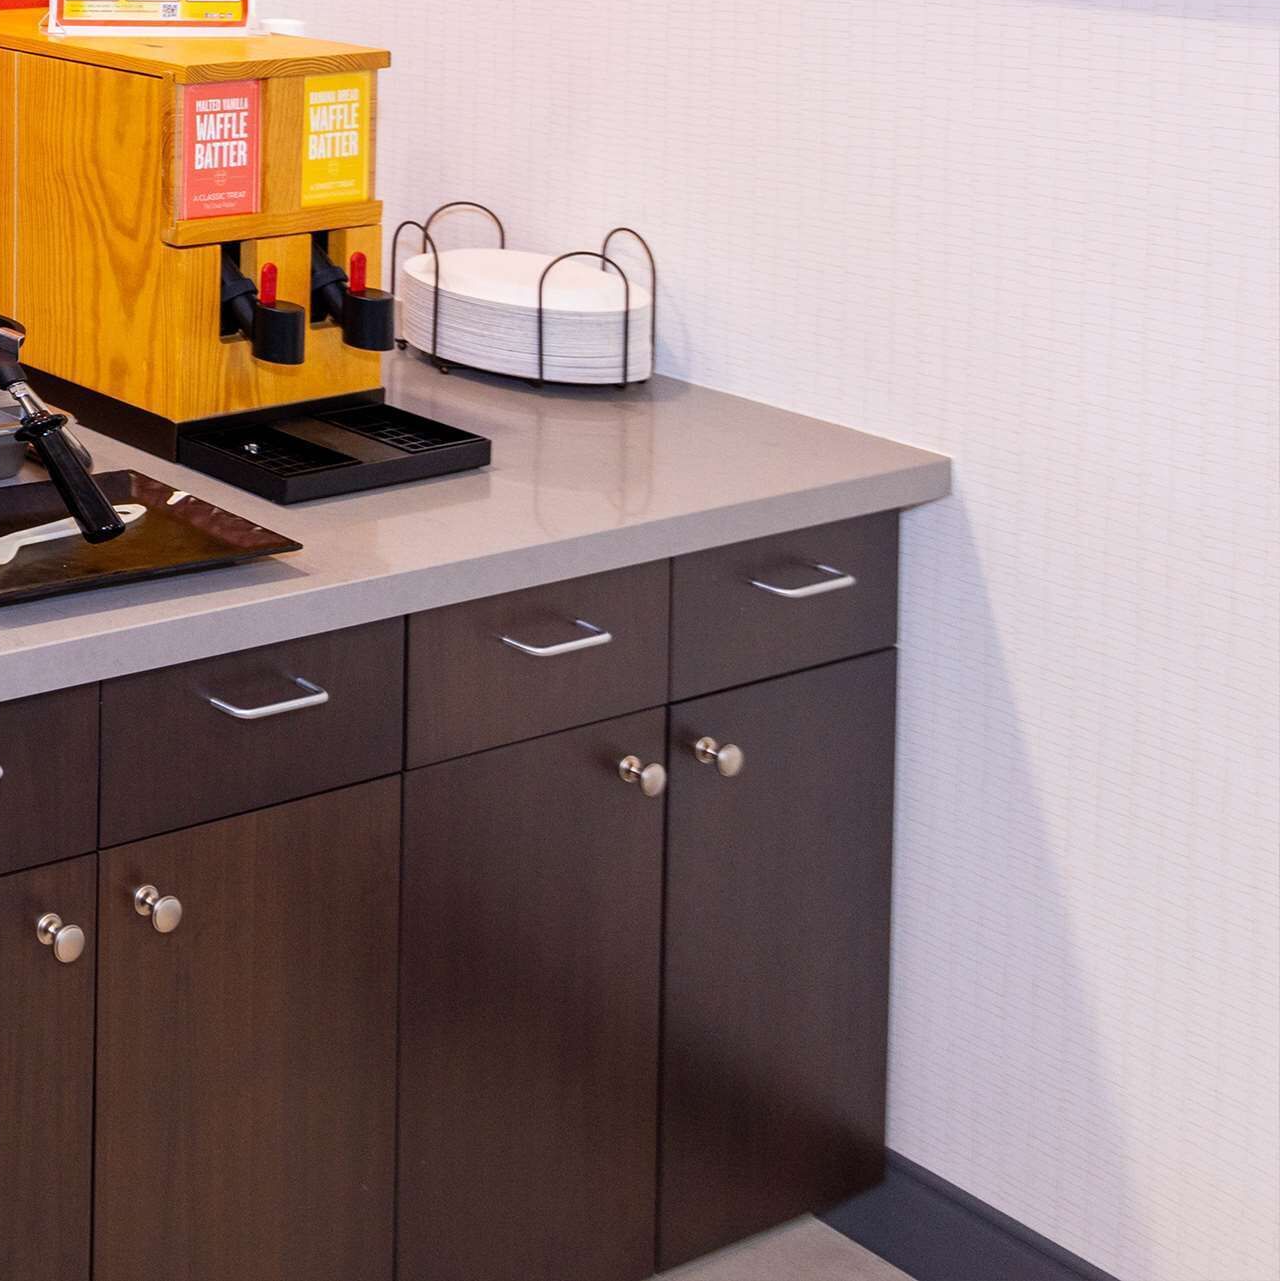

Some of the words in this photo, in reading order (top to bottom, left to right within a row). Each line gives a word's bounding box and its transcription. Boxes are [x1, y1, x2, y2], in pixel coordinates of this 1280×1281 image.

[196, 111, 249, 141] WAFFLE
[309, 102, 360, 133] WAFFLE
[194, 140, 247, 170] BATTER
[308, 130, 359, 160] BATTER
